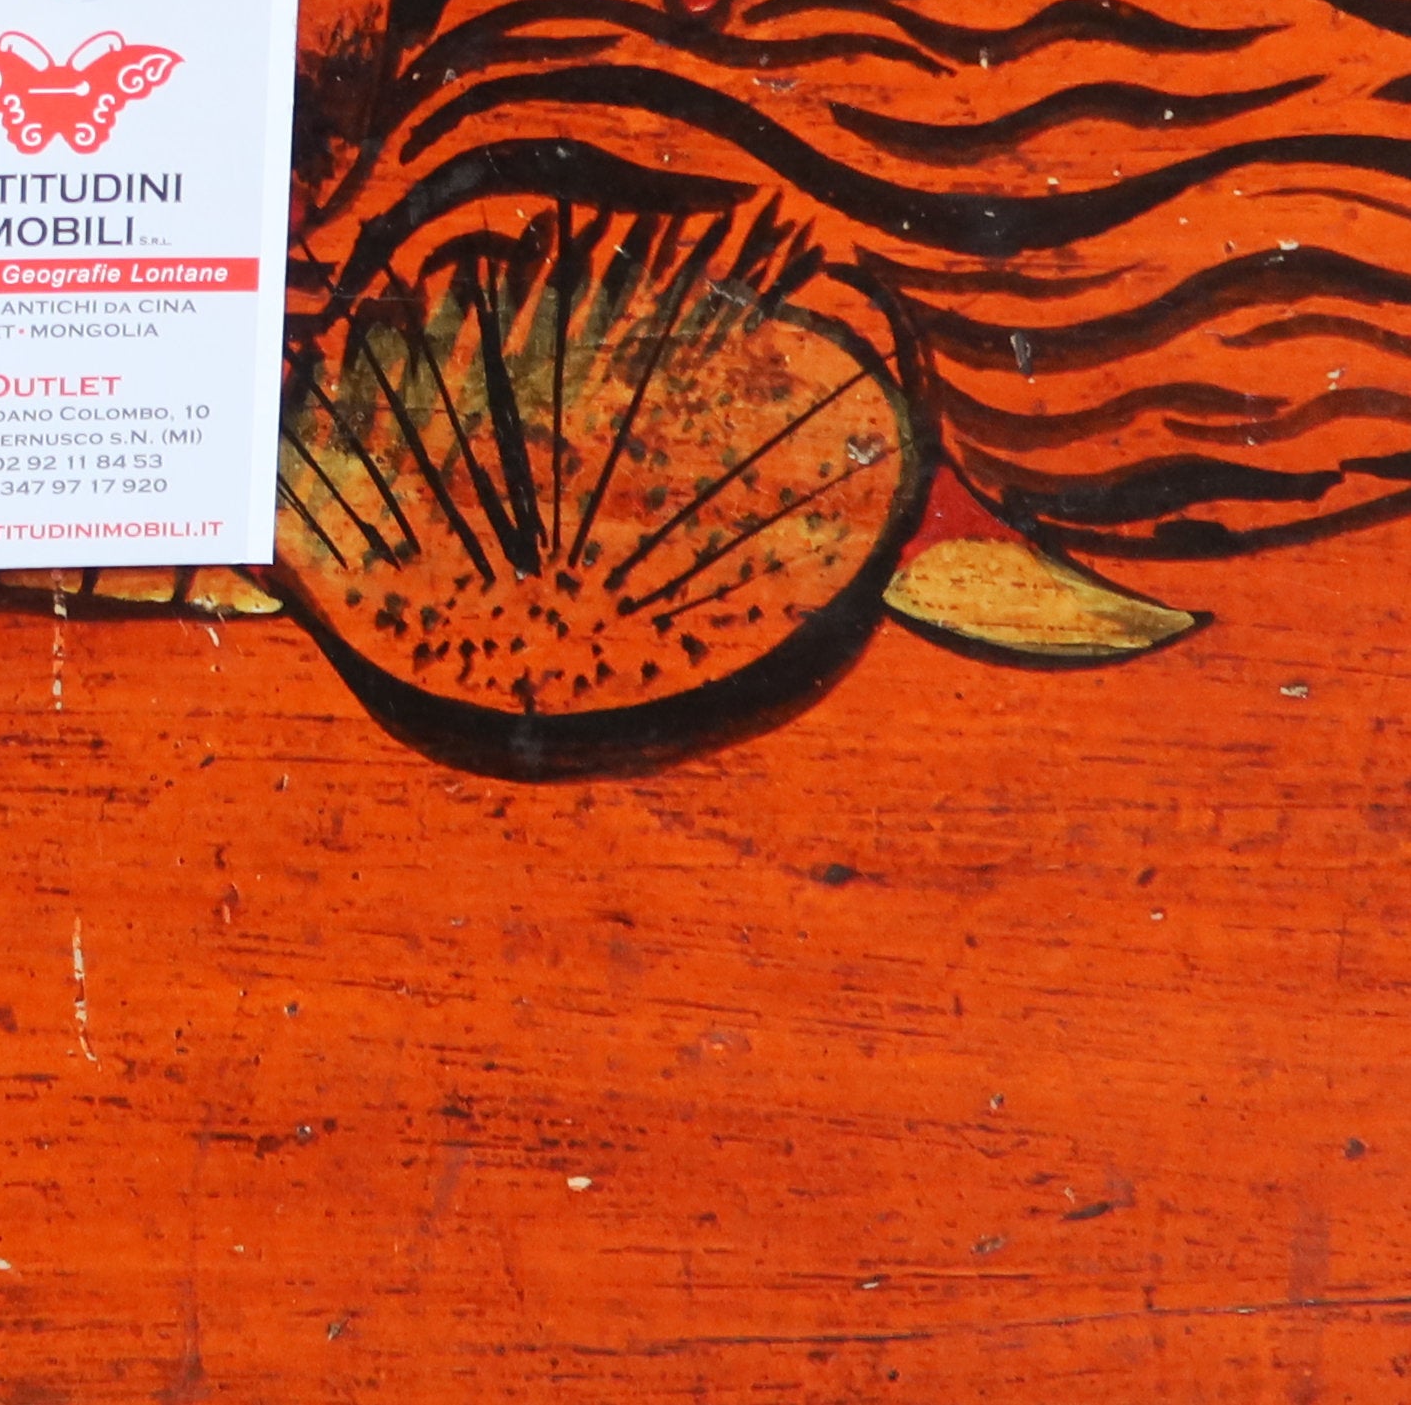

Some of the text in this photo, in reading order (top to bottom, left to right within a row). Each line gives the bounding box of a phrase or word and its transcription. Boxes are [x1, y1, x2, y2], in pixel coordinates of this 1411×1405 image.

[2, 264, 121, 288] Geografie
[131, 264, 228, 283] Lontane
[1, 300, 96, 316] ANTICHI
[138, 299, 196, 314] CINA
[185, 404, 210, 420] 10
[162, 428, 203, 445] (MI)
[27, 456, 57, 471] 92
[67, 456, 87, 470] 11
[96, 454, 126, 469] 84
[133, 454, 163, 468] 53
[0, 481, 44, 496] 347
[52, 480, 81, 495] 97
[91, 479, 116, 494] 17
[122, 478, 167, 493] 920
